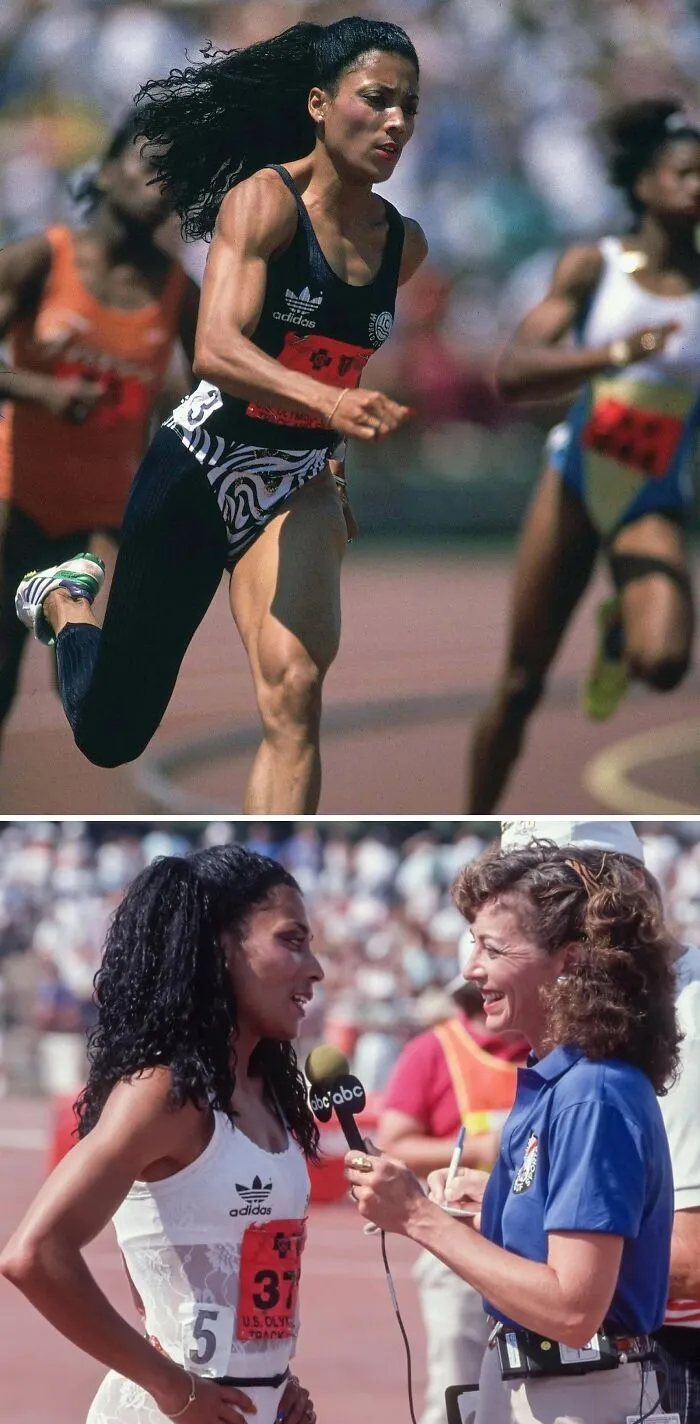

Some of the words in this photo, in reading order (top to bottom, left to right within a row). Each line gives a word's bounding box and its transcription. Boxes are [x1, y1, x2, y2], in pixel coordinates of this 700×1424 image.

[273, 311, 316, 328] adidas
[188, 389, 219, 426] 3
[311, 1094, 330, 1111] abc
[332, 1085, 364, 1105] abc
[229, 1205, 272, 1217] adidas
[252, 1268, 300, 1310] 37
[189, 1309, 219, 1366] 5
